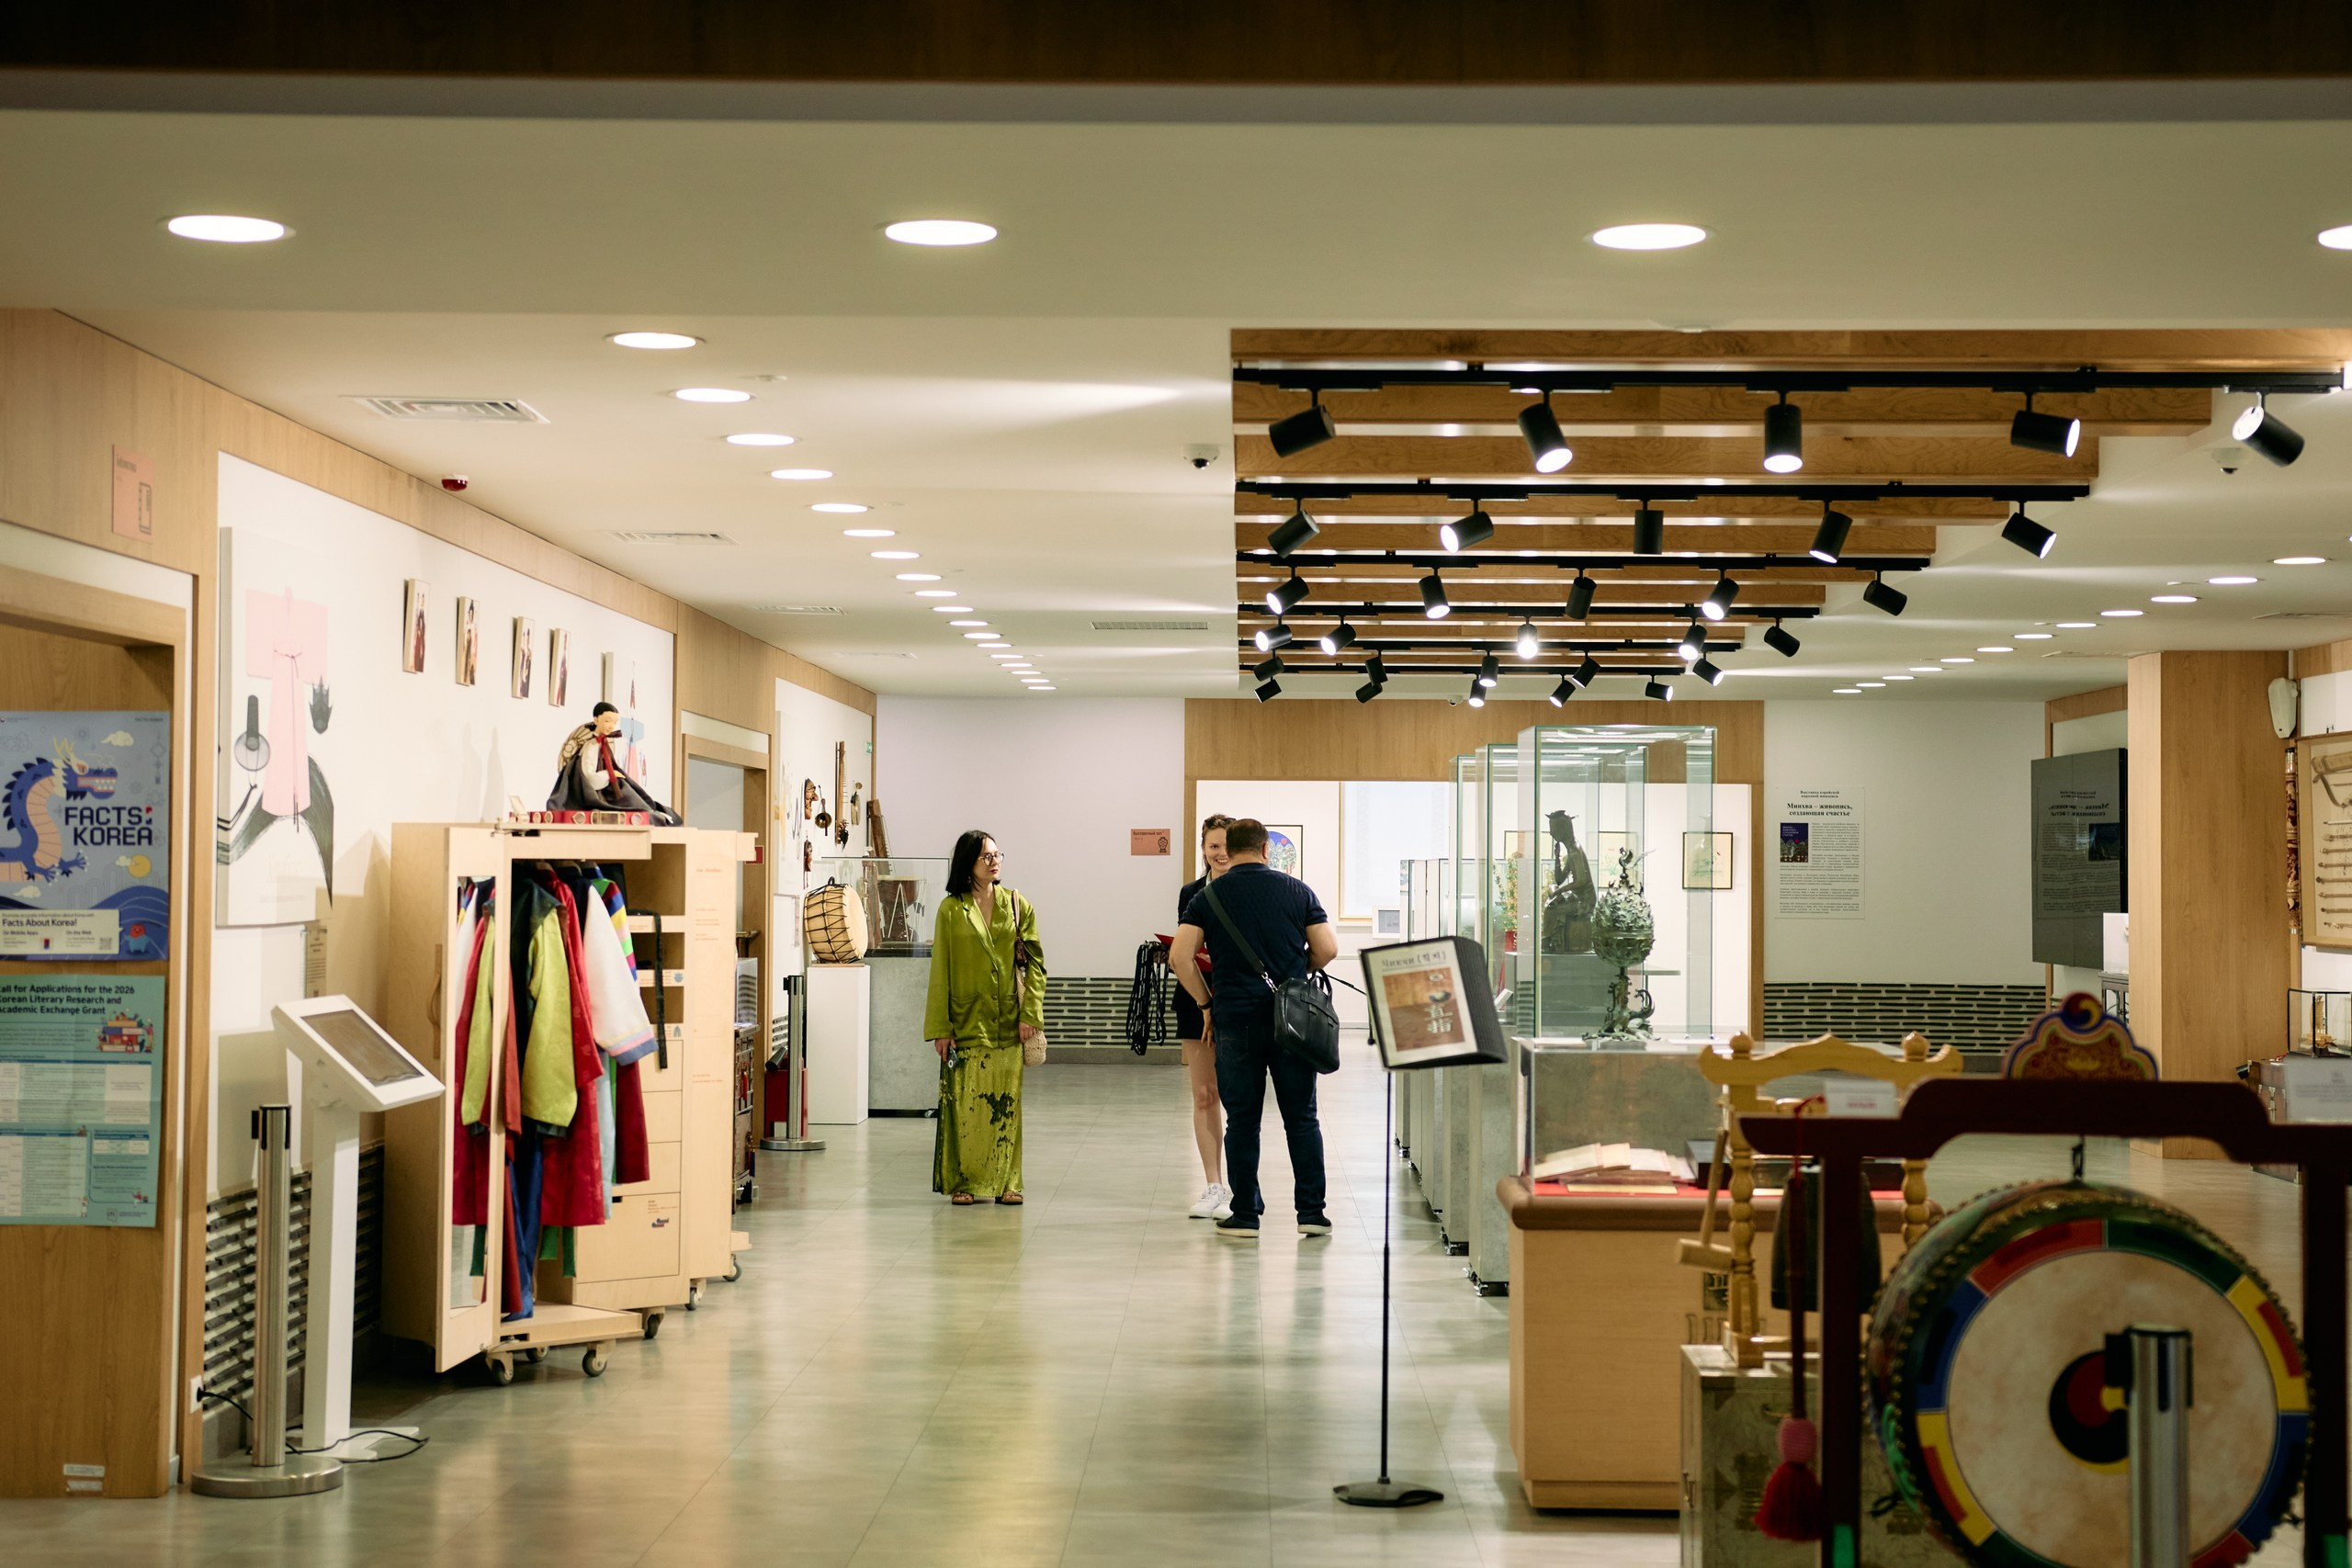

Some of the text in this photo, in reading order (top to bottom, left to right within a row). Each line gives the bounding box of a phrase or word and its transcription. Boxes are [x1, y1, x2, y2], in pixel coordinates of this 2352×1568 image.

[74, 827, 153, 846] KOREA
[2, 919, 77, 927] Facts About Korea!
[0, 985, 135, 994] all for Applications for the 2026
[29, 995, 64, 1005] Literary
[66, 995, 105, 1004] Research
[106, 996, 122, 1005] and
[40, 1005, 80, 1016] Exchange
[82, 1006, 106, 1015] Grant
